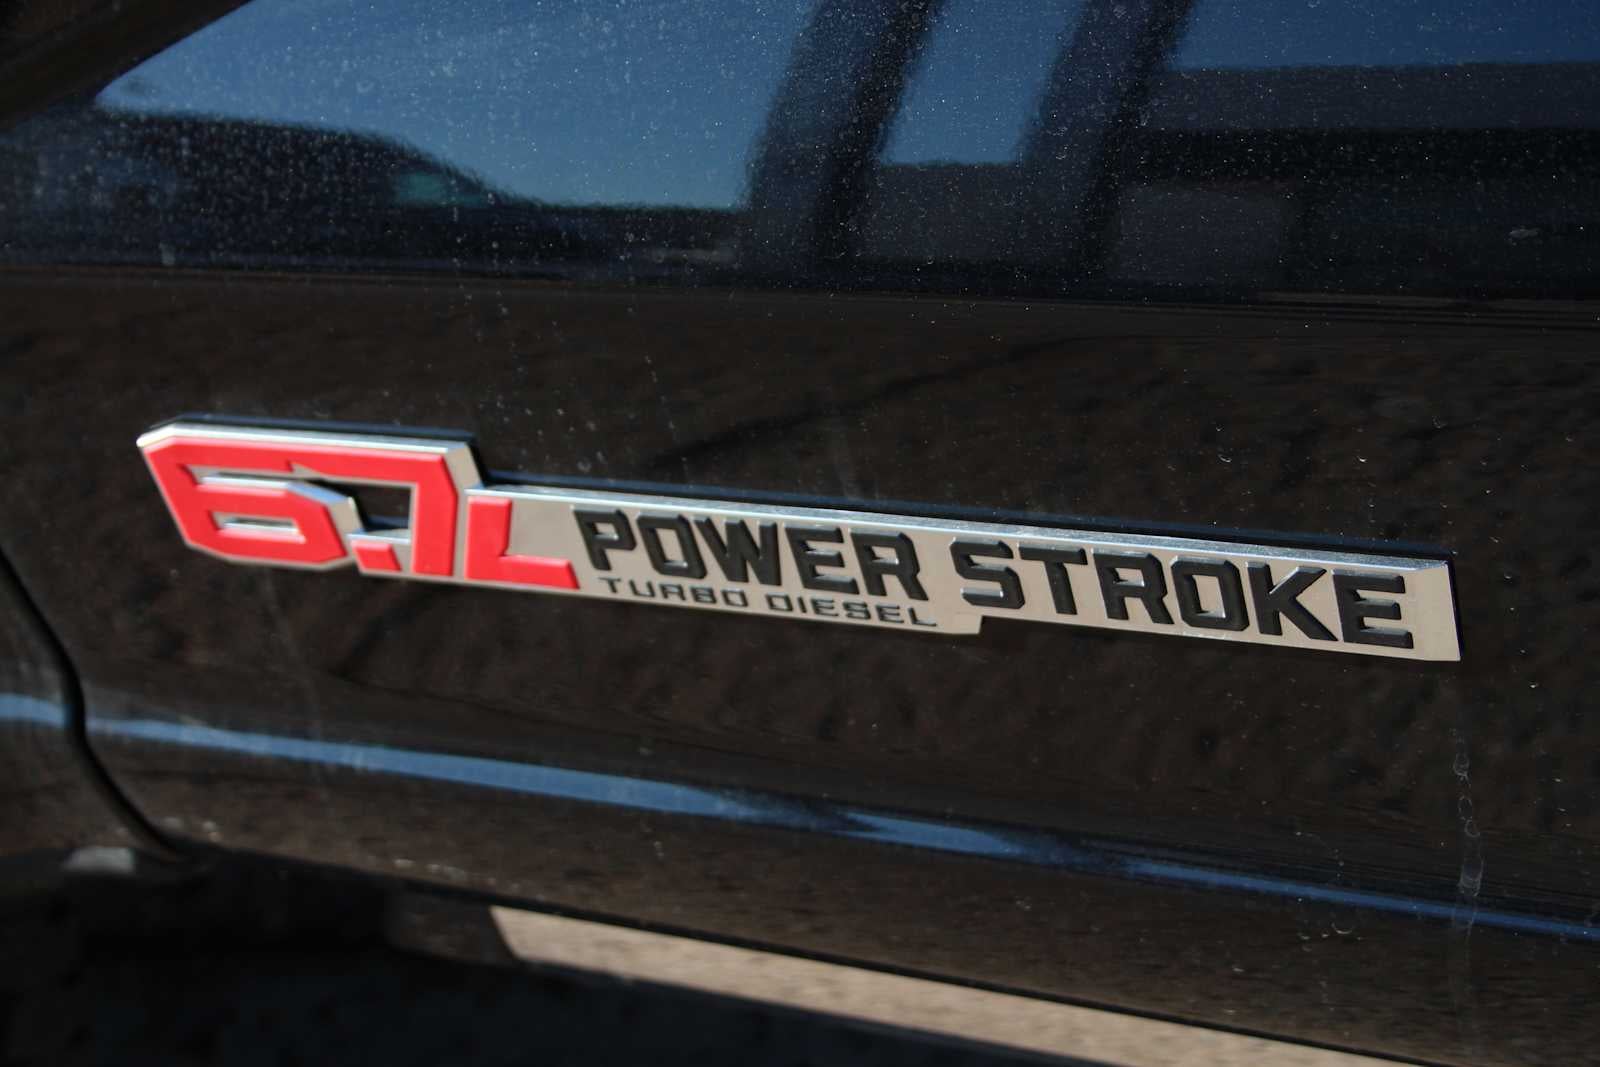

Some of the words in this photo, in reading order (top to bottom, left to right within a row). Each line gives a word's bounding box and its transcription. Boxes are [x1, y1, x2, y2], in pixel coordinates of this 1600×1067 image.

[572, 506, 929, 601] POWER
[949, 536, 1415, 649] STROKE
[598, 576, 750, 608] TURBO
[765, 594, 938, 628] DIESEL
